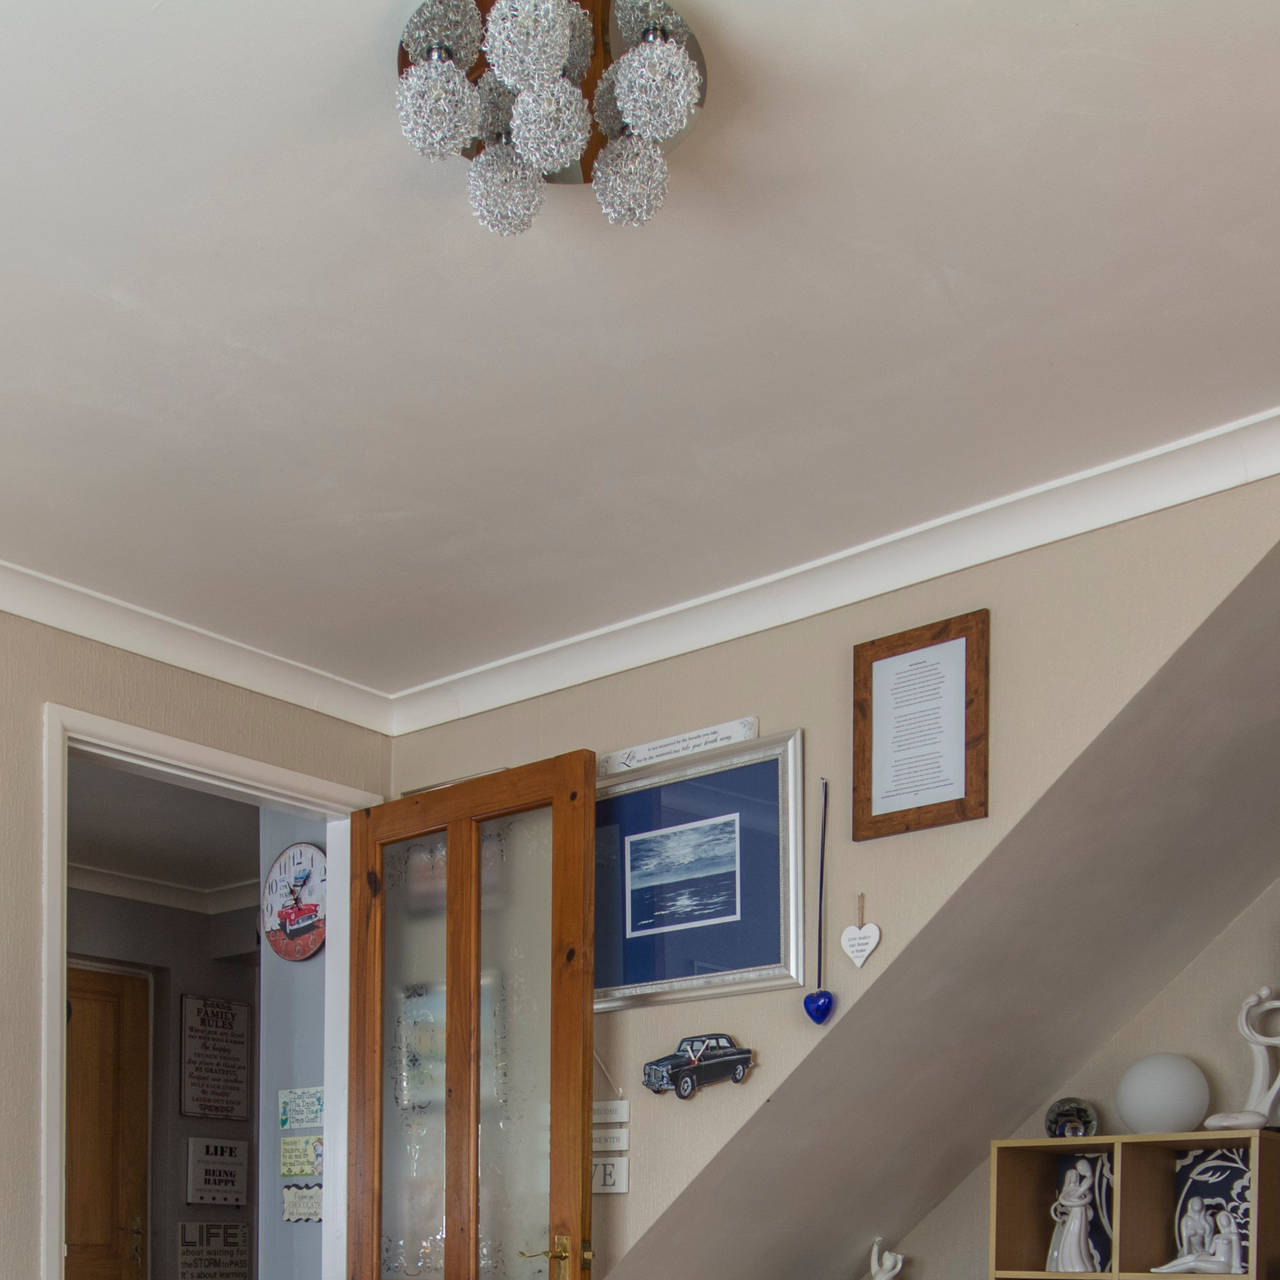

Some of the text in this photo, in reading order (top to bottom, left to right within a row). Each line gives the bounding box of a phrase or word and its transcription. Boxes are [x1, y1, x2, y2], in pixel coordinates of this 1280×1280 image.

[292, 849, 303, 866] 12
[268, 879, 278, 897] 10
[197, 1007, 237, 1022] FAMILY
[200, 1017, 234, 1031] RULES
[205, 1145, 238, 1158] LIFE
[204, 1168, 237, 1179] BEING
[204, 1178, 236, 1187] HAPPY
[181, 1223, 241, 1248] LIFE
